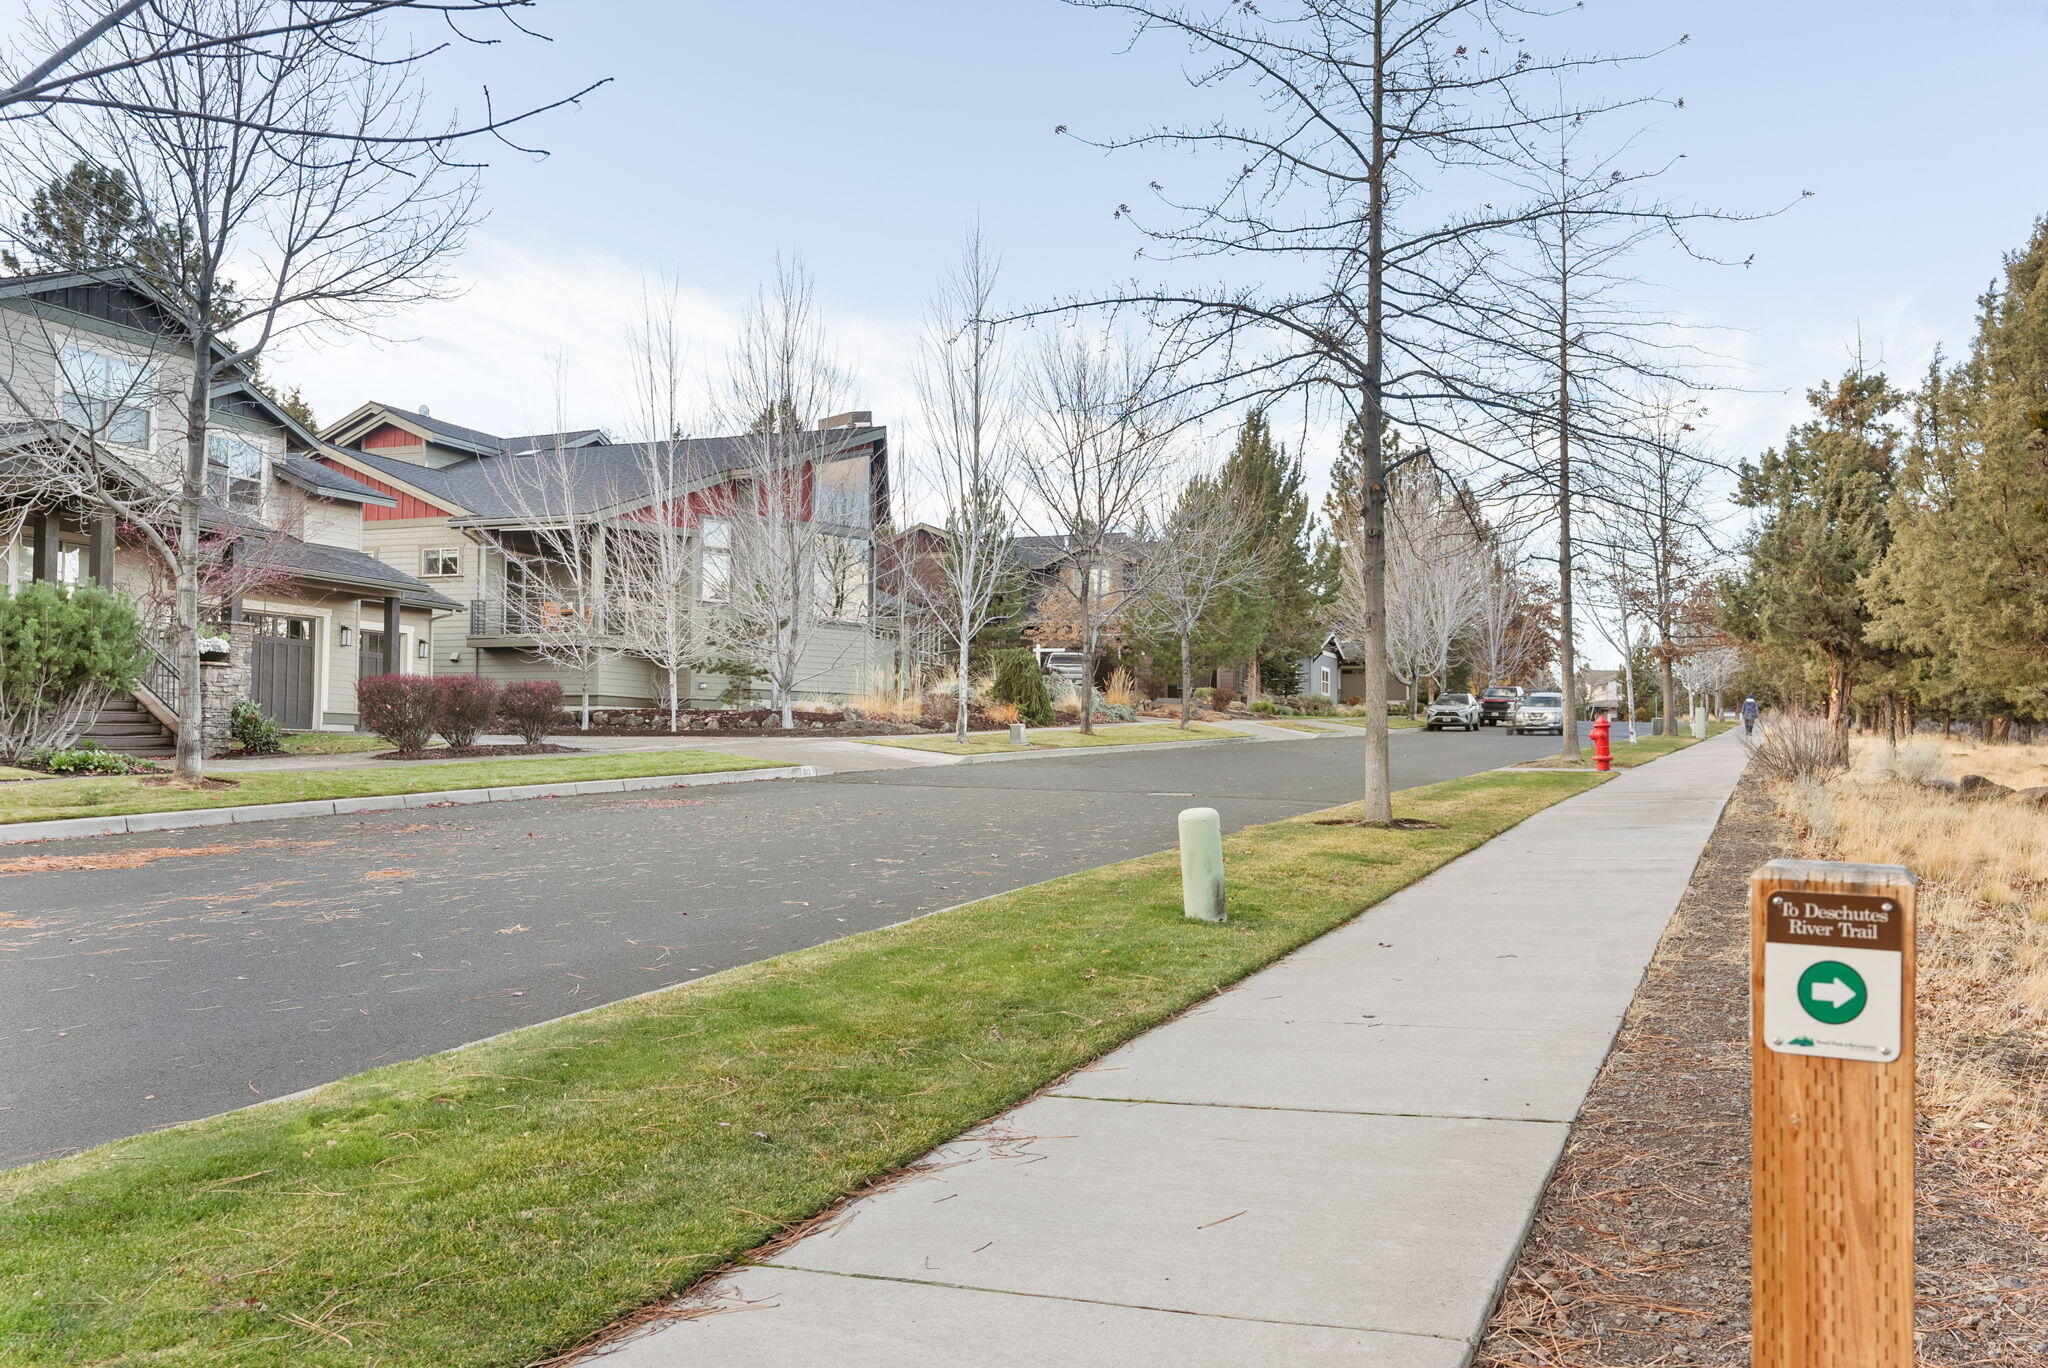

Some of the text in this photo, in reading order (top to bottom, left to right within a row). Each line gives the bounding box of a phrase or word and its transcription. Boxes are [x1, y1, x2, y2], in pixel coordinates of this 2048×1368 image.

[1782, 902, 1889, 922] To Deschutes
[1789, 919, 1878, 940] River Trail
